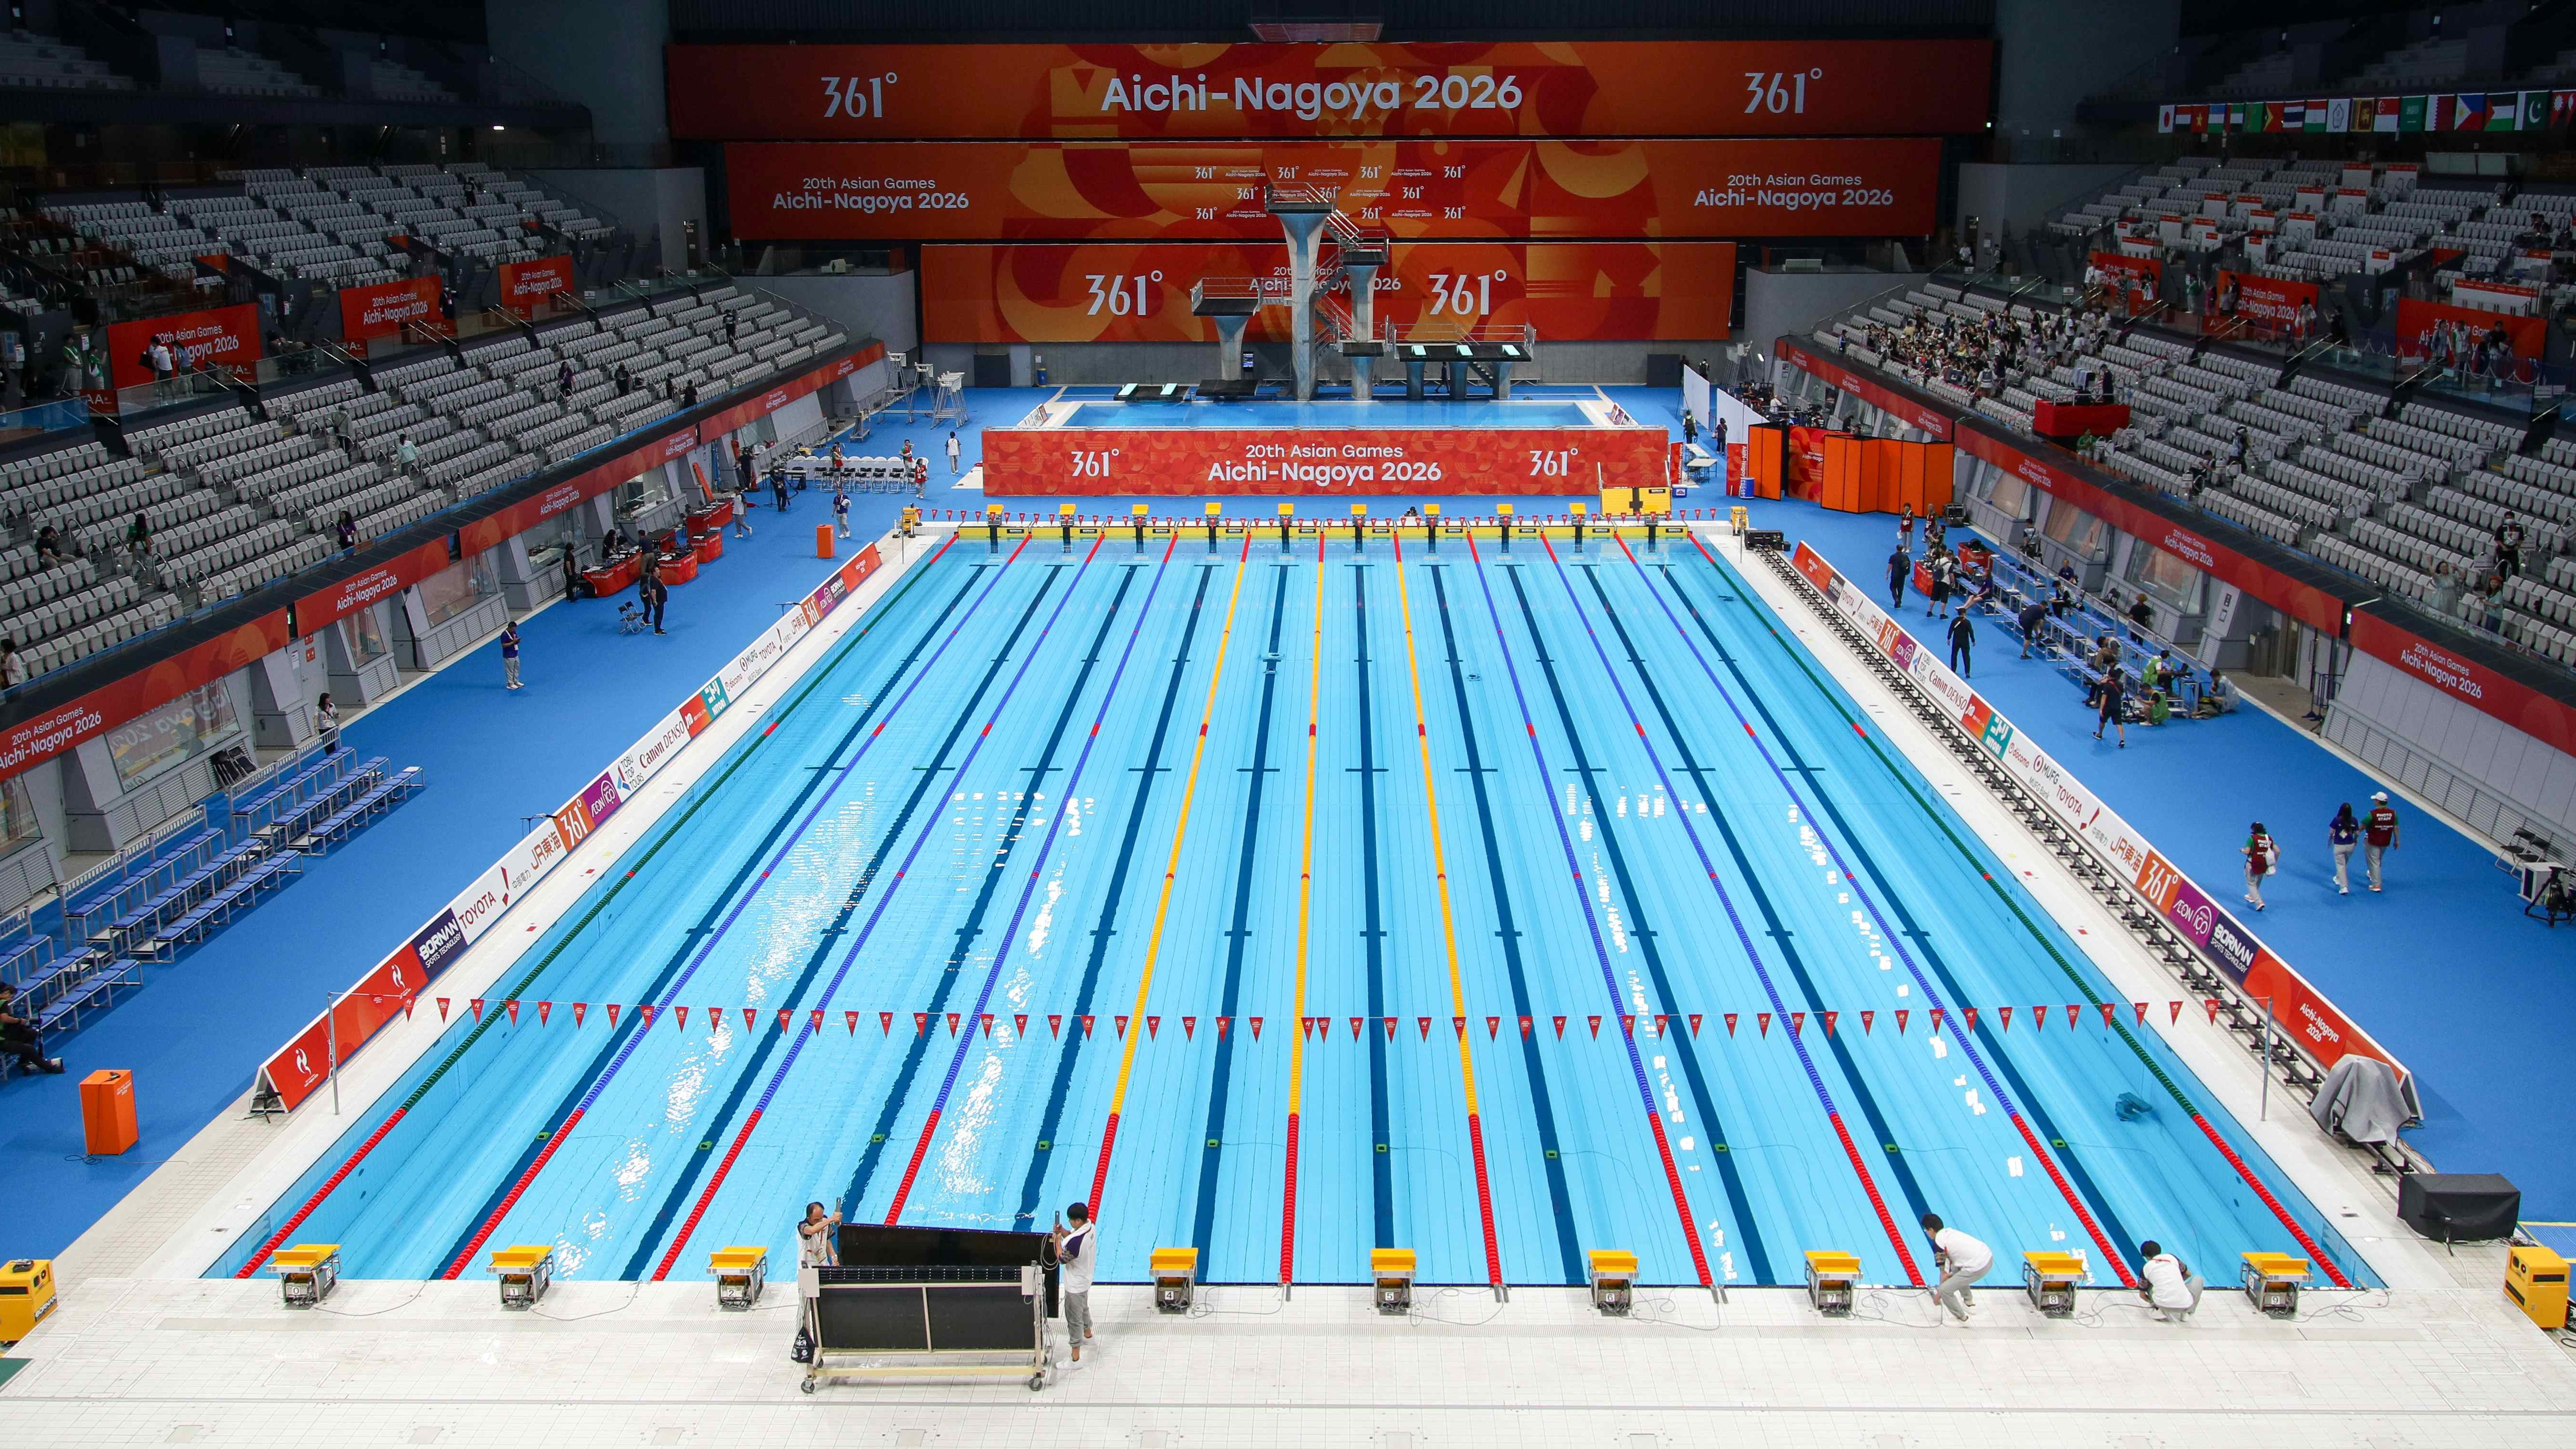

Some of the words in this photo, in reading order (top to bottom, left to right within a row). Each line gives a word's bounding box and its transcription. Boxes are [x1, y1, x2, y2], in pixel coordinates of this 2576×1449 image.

[1101, 73, 1401, 120] Aichi-Nagoya
[1414, 74, 1523, 109] 2026
[803, 178, 836, 189] 20th
[841, 177, 880, 189] Asian
[884, 178, 936, 189] Games
[1727, 174, 1760, 186] 20th
[1766, 174, 1805, 185] Asian
[1810, 174, 1862, 185] Games
[772, 192, 912, 214] Aichi-Nagoya
[919, 192, 969, 209] 2026
[1694, 189, 1836, 211] Aichi-Nagoya
[1842, 189, 1893, 206] 2026
[1274, 266, 1291, 276] 20t
[1373, 277, 1402, 290] 026
[372, 297, 385, 307] 20th
[386, 294, 399, 304] Asian
[401, 292, 417, 302] Games
[2267, 291, 2286, 302] Games
[363, 305, 410, 325] Aichi-Nagoya
[411, 301, 428, 315] 2026
[2238, 297, 2275, 320] chi-Nagoya
[2277, 304, 2295, 321] 2026
[176, 328, 196, 341] Asian
[197, 325, 222, 338] Games
[214, 334, 239, 354] 2026
[1245, 444, 1285, 458] 20th
[1290, 444, 1336, 458] Asian
[1342, 445, 1403, 458] Games
[1208, 460, 1374, 487] Aichi-Nagoya
[1381, 462, 1442, 481] 2026
[540, 495, 569, 515] Aichi-Nagoya
[569, 489, 580, 502] 2026
[2164, 535, 2198, 561] Aichi-Nagoya
[2199, 552, 2213, 567] 2026
[336, 584, 381, 612] Aichi-Nagoya
[381, 575, 397, 592] 2026
[345, 583, 356, 594] 20th
[357, 576, 370, 589] Asian
[370, 570, 387, 583] Games
[1841, 590, 1854, 607] TOYOTA
[759, 641, 776, 661] TOYOTA
[2414, 643, 2428, 657] 20th
[2429, 650, 2446, 666] Asian
[2447, 658, 2470, 677] Games
[1929, 670, 1948, 694] Canon
[2401, 649, 2457, 688] Aichi-Nagoya
[2459, 676, 2482, 700] 2026
[1946, 687, 1967, 710] DENSO
[12, 728, 31, 747] 20th
[34, 720, 55, 737] Asian
[56, 706, 83, 725] Games
[663, 721, 685, 748] DENSO
[0, 725, 73, 769] Aichi-Nagoya
[76, 711, 102, 735] 2026
[621, 754, 633, 770] TOBU
[639, 741, 665, 769] Canon
[2012, 748, 2029, 768] docomo
[625, 766, 634, 778] TOP
[629, 772, 644, 790] TOURS
[2041, 763, 2058, 784] MUFG
[2056, 784, 2082, 817] TOYOTA
[530, 830, 562, 870] JR東海
[2110, 835, 2143, 873] JR東海
[459, 891, 496, 929] TOYOTA
[418, 919, 460, 961] BORNAN
[425, 952, 440, 968] SPORTS
[439, 934, 462, 956] TECHNOLOGY
[2213, 923, 2254, 966] BORNAN
[2210, 938, 2225, 954] SPORTS
[2224, 950, 2246, 974] TECHNOLOGY
[2300, 1002, 2339, 1043] Aichi-Nagoya
[2306, 1023, 2322, 1043] 2026
[35, 1295, 57, 1319] BORNAN
[1608, 1293, 1613, 1301] 6
[2272, 1296, 2278, 1304] 9
